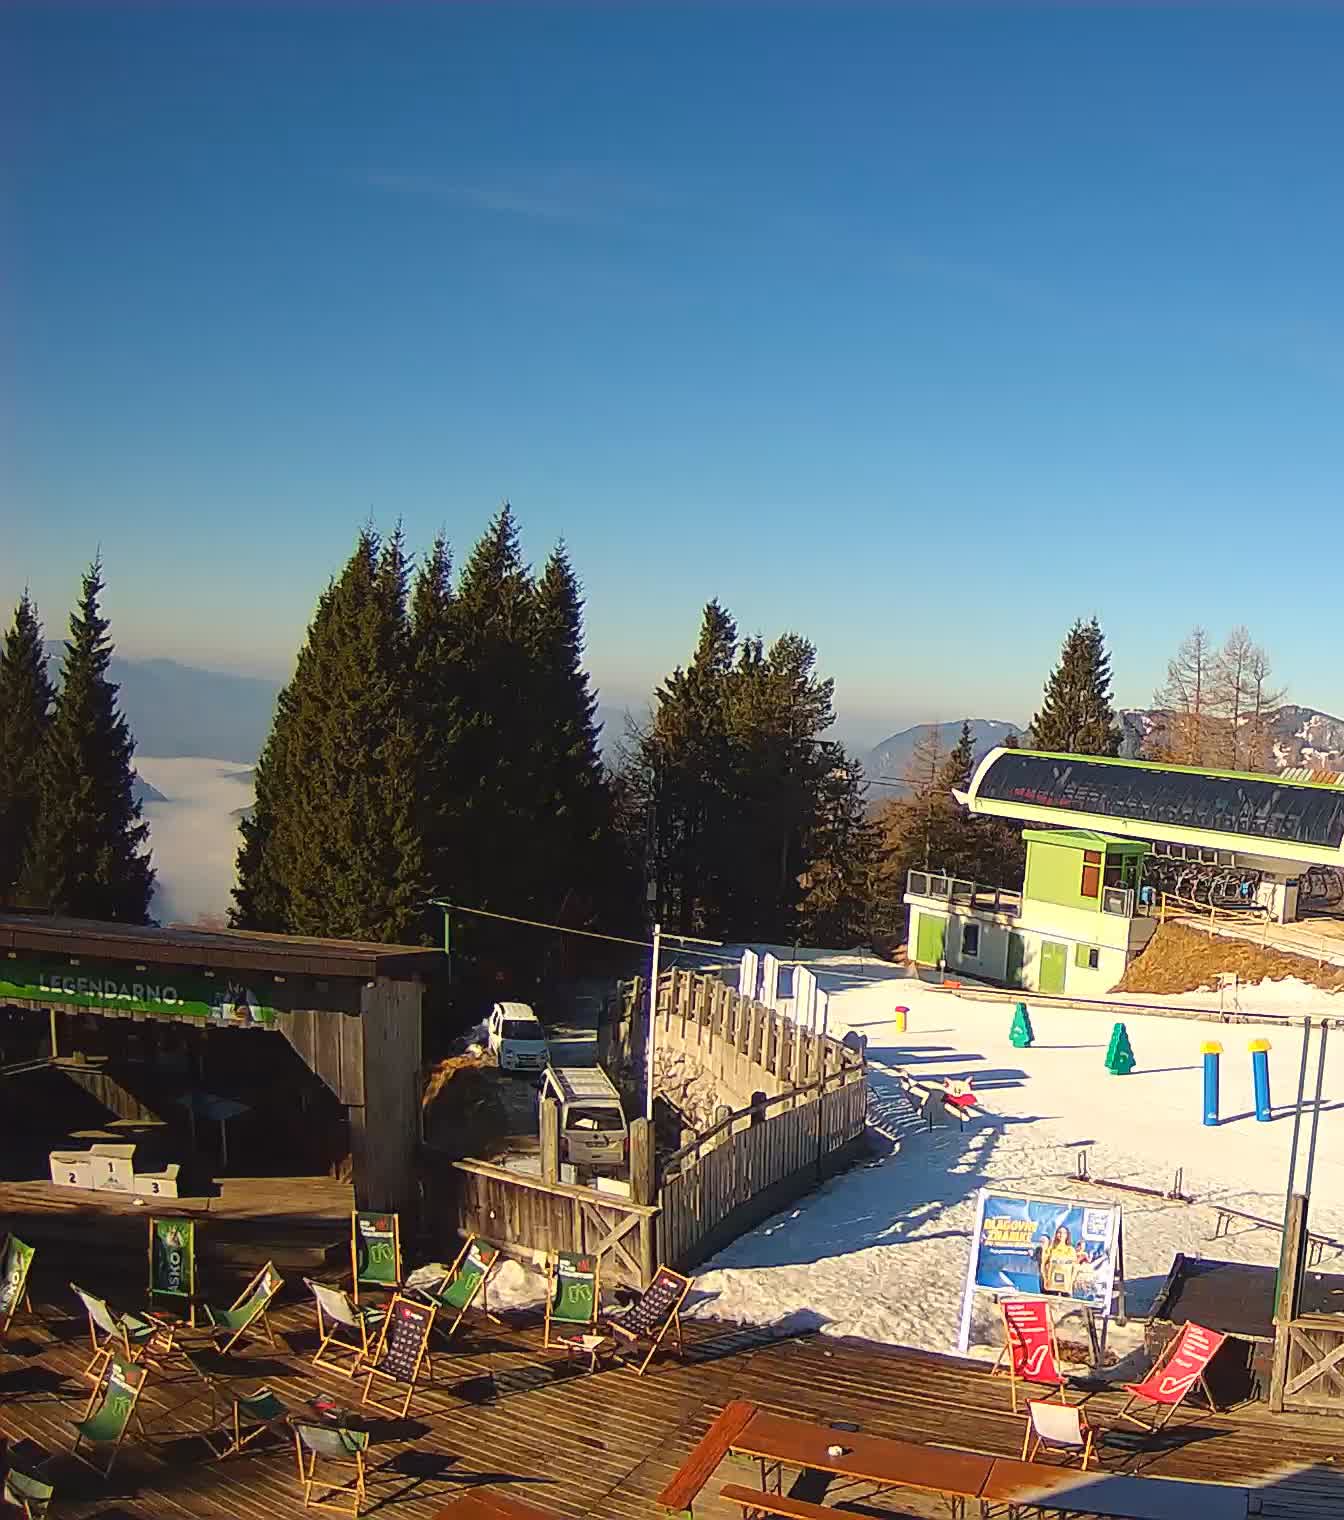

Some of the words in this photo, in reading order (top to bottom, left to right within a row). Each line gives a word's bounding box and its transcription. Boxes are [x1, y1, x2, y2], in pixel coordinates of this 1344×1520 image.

[108, 1161, 114, 1173] 1
[68, 1172, 77, 1184] 2
[151, 1182, 160, 1194] 3
